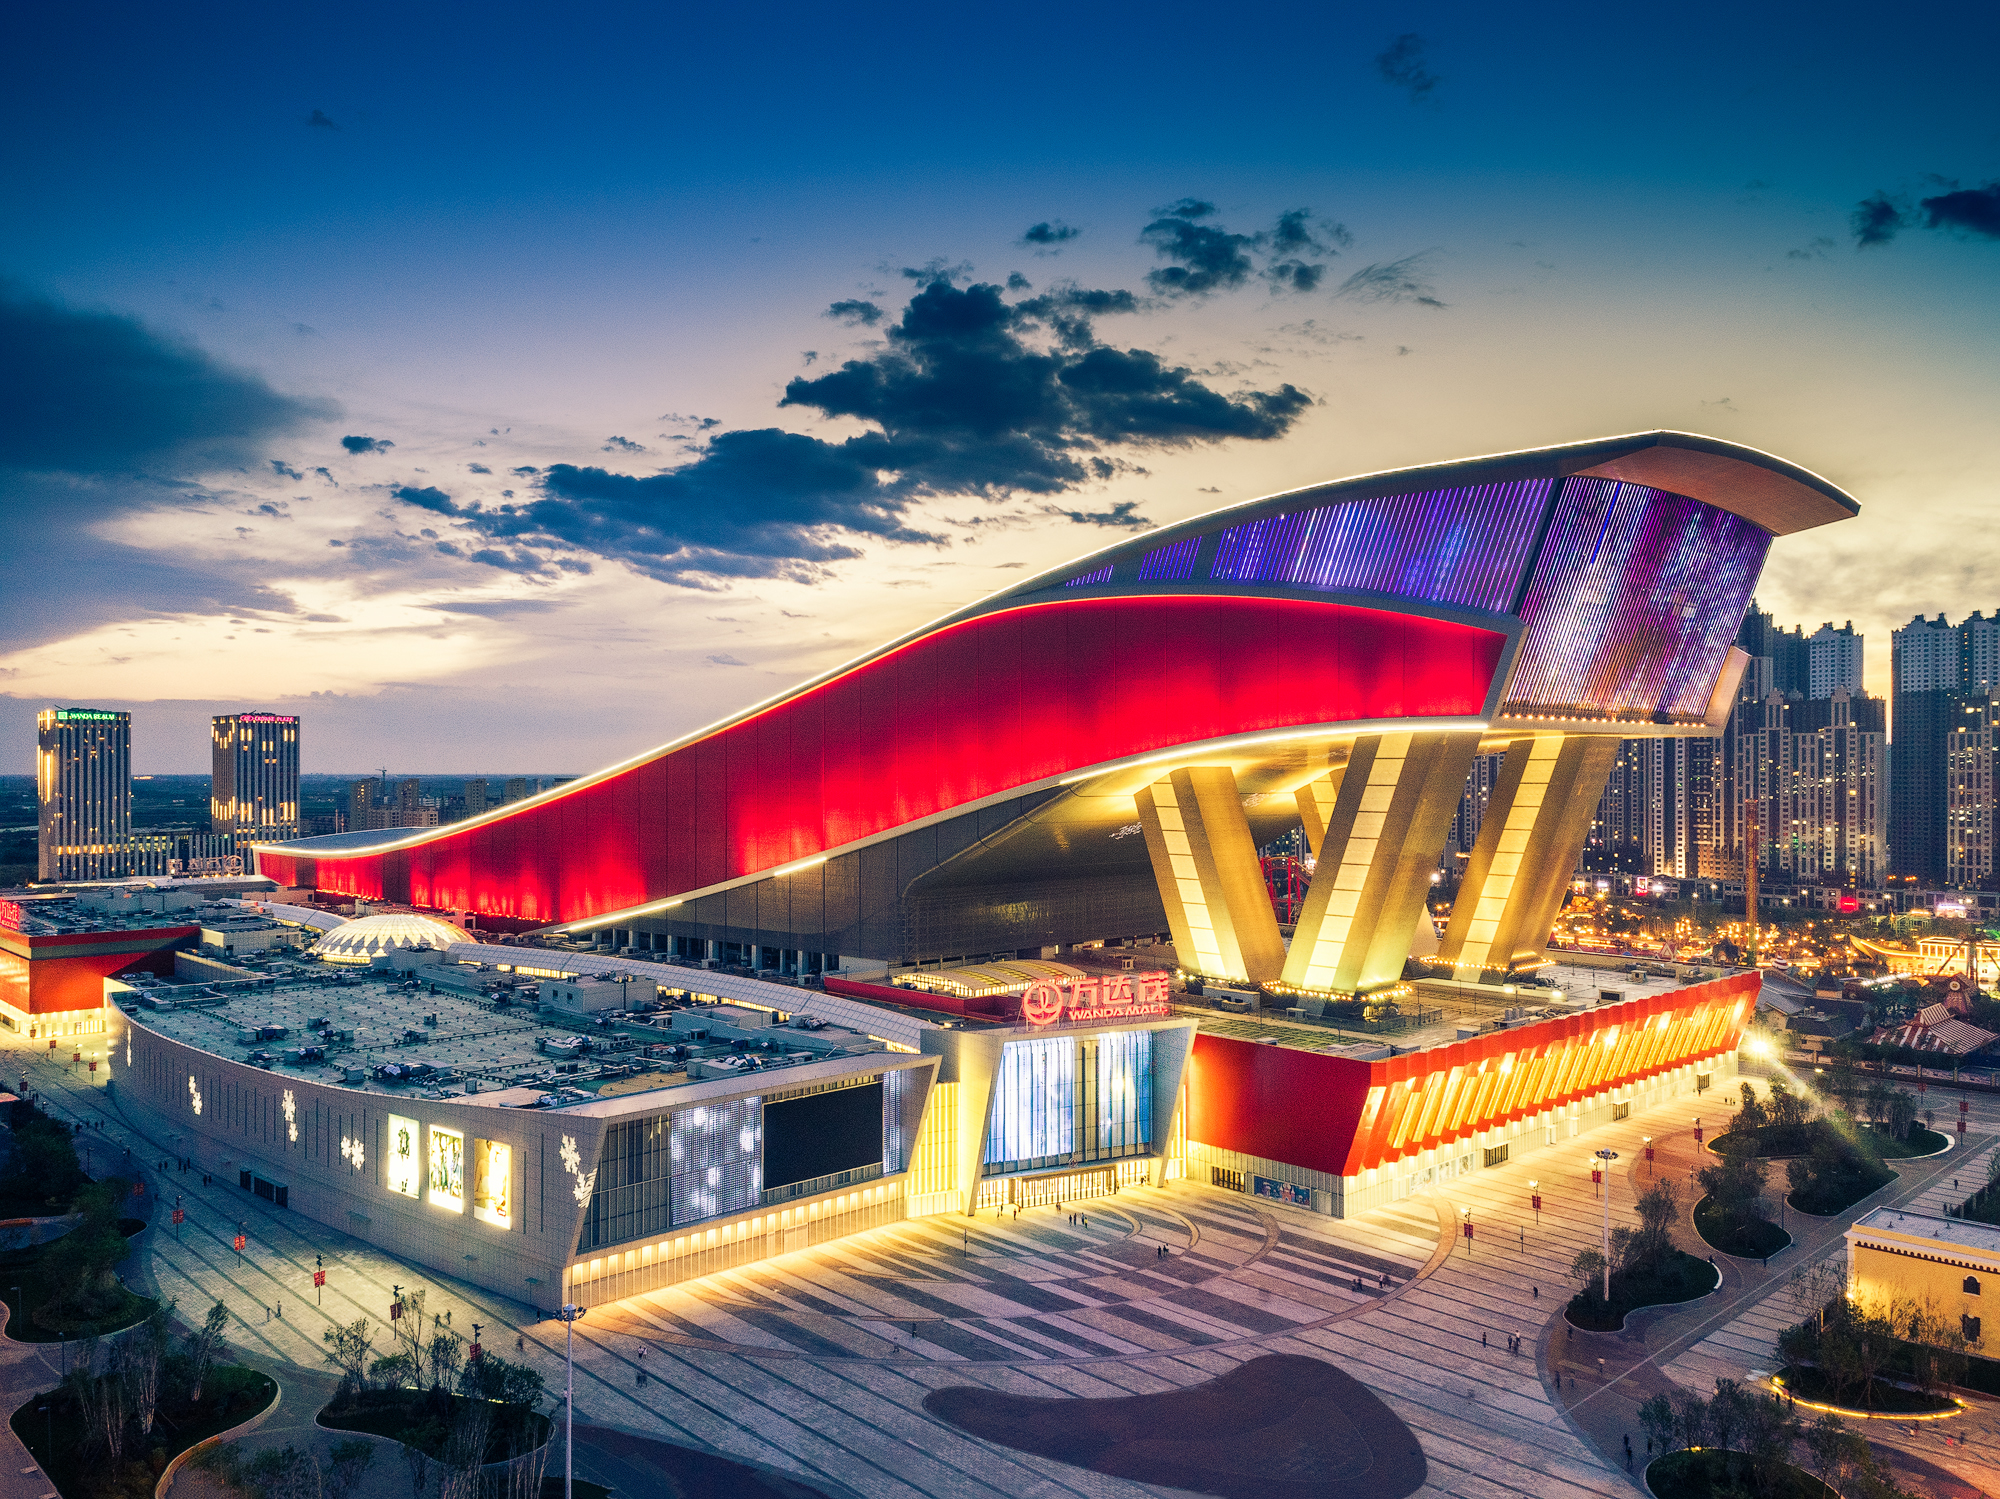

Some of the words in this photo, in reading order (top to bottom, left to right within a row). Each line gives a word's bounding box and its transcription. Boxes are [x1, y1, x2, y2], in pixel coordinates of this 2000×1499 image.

[1068, 970, 1169, 1008] 万达茂
[1069, 1008, 1123, 1020] WANDA
[1125, 1003, 1168, 1015] MALL
